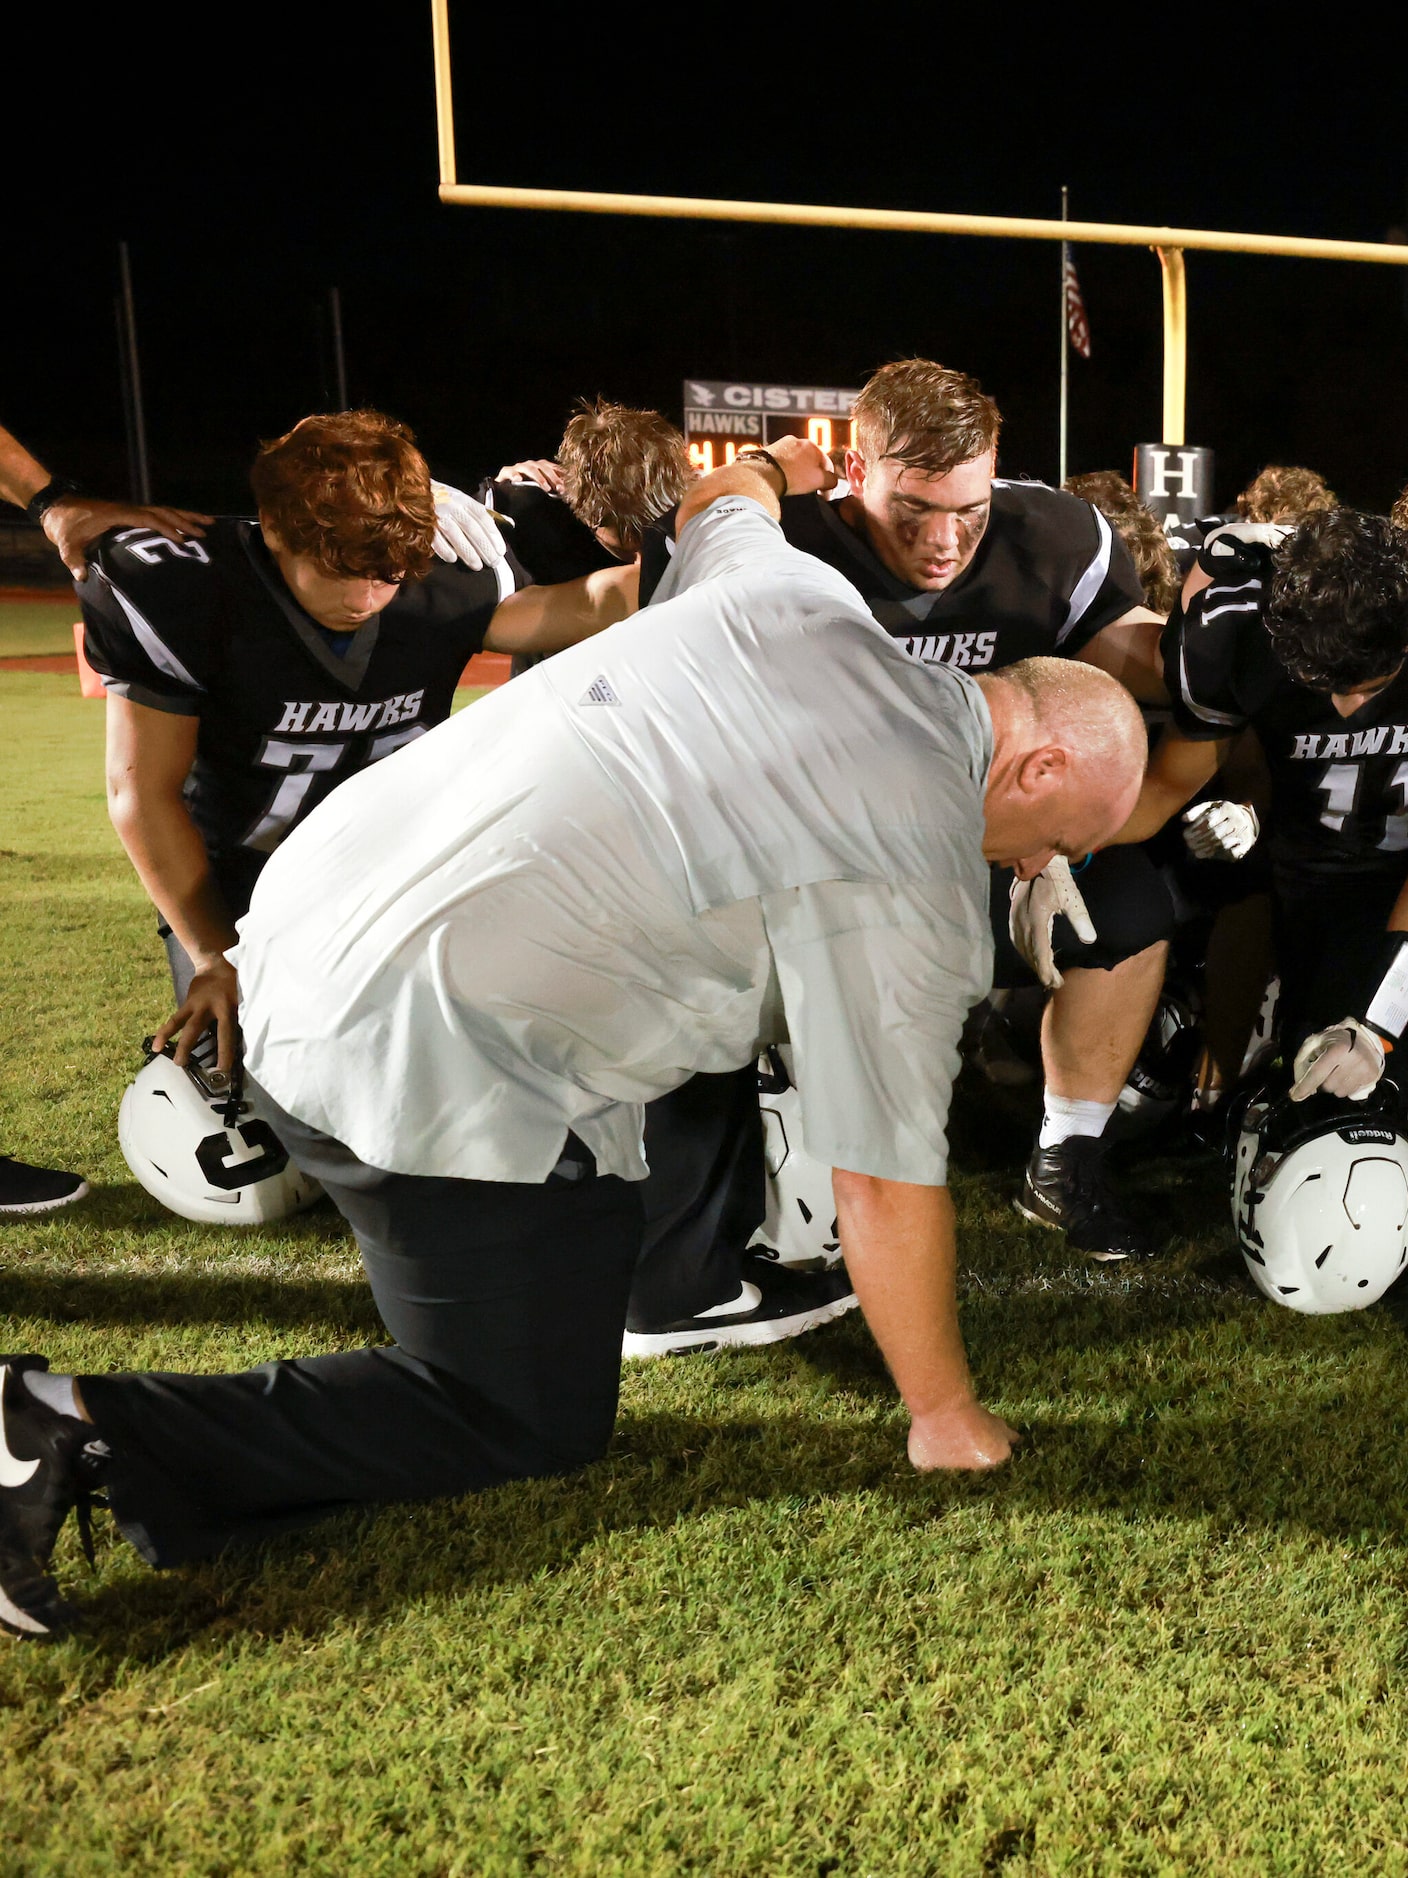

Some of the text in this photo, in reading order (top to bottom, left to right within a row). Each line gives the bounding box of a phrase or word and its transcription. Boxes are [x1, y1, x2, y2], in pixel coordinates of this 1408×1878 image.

[688, 413, 760, 435] HAWKS
[1202, 578, 1262, 625] 11
[273, 689, 425, 733] HAWKS
[1349, 1129, 1393, 1140] Riddell
